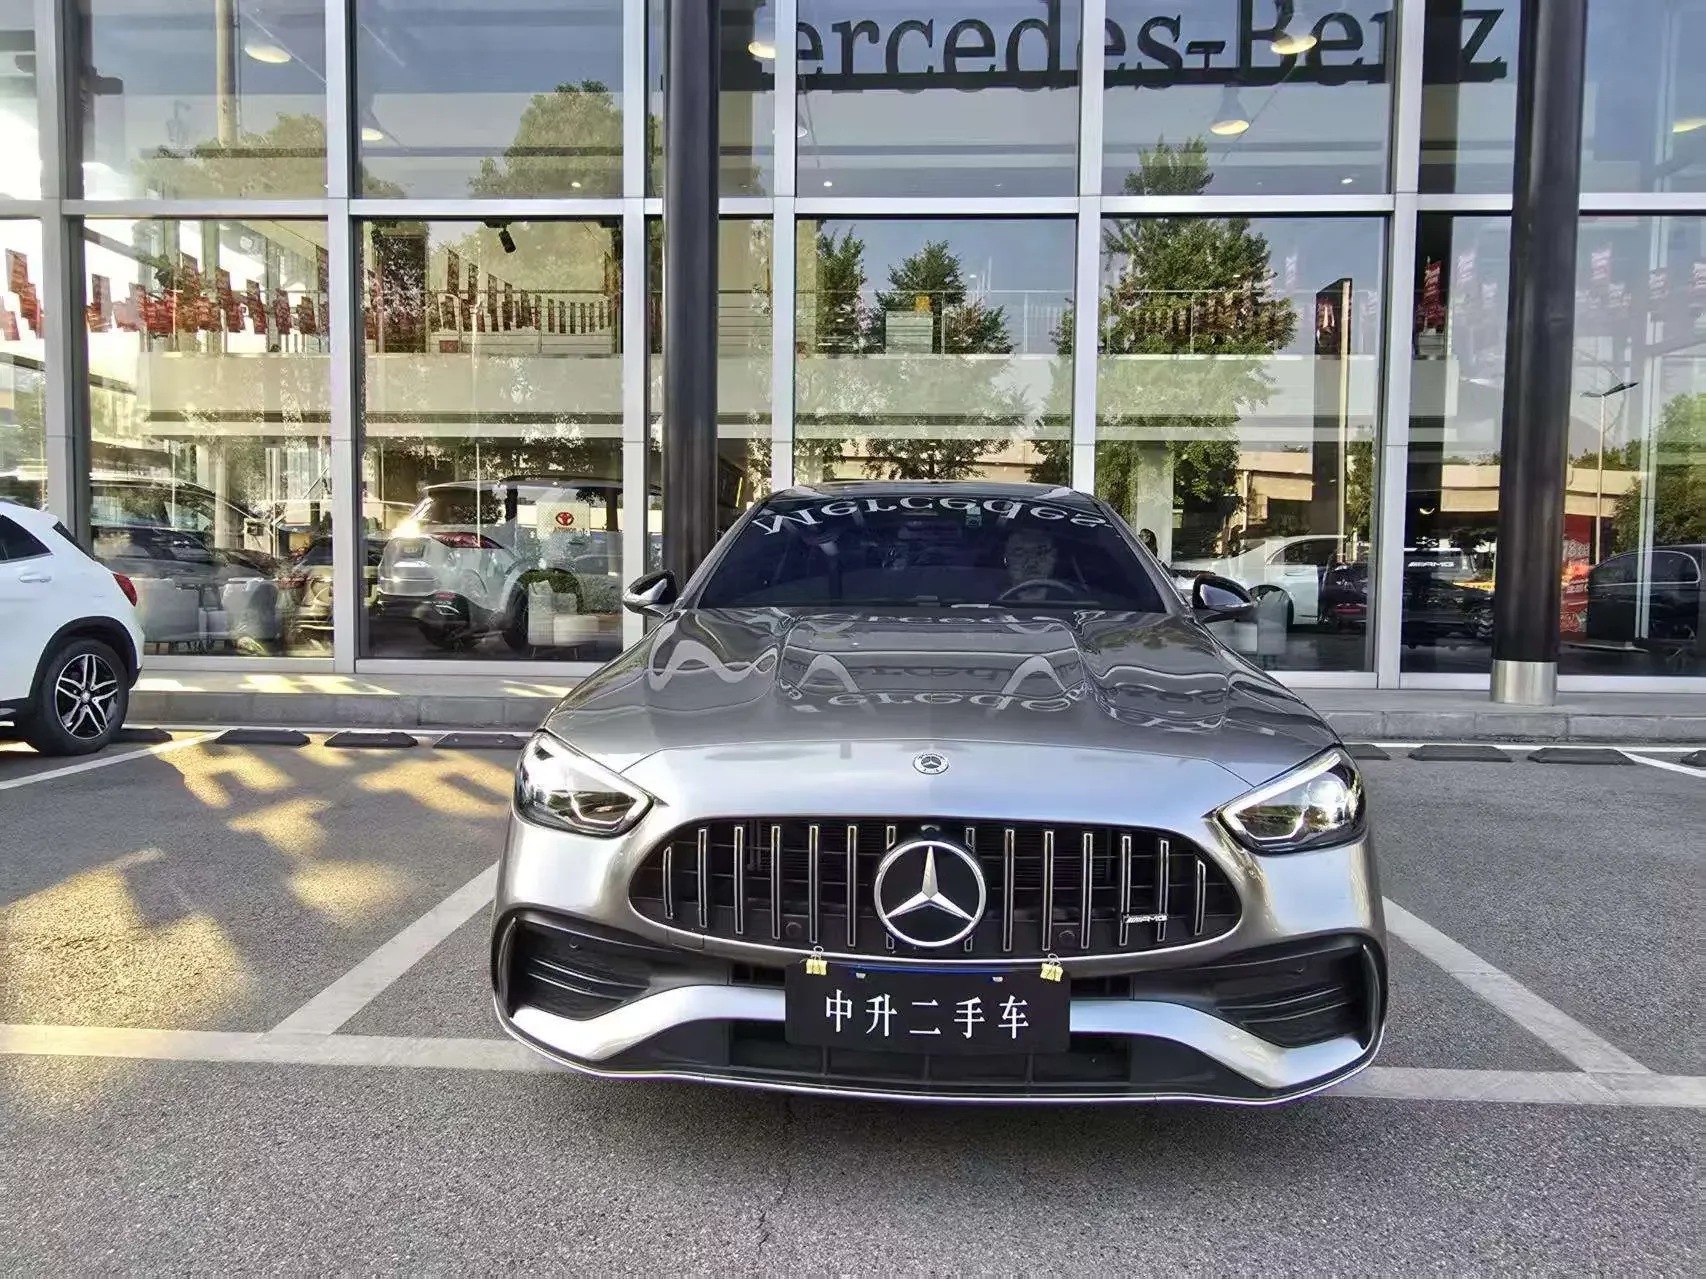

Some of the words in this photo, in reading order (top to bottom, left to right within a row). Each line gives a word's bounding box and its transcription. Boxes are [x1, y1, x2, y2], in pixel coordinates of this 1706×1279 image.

[825, 989, 1030, 1040] 中升二手车
